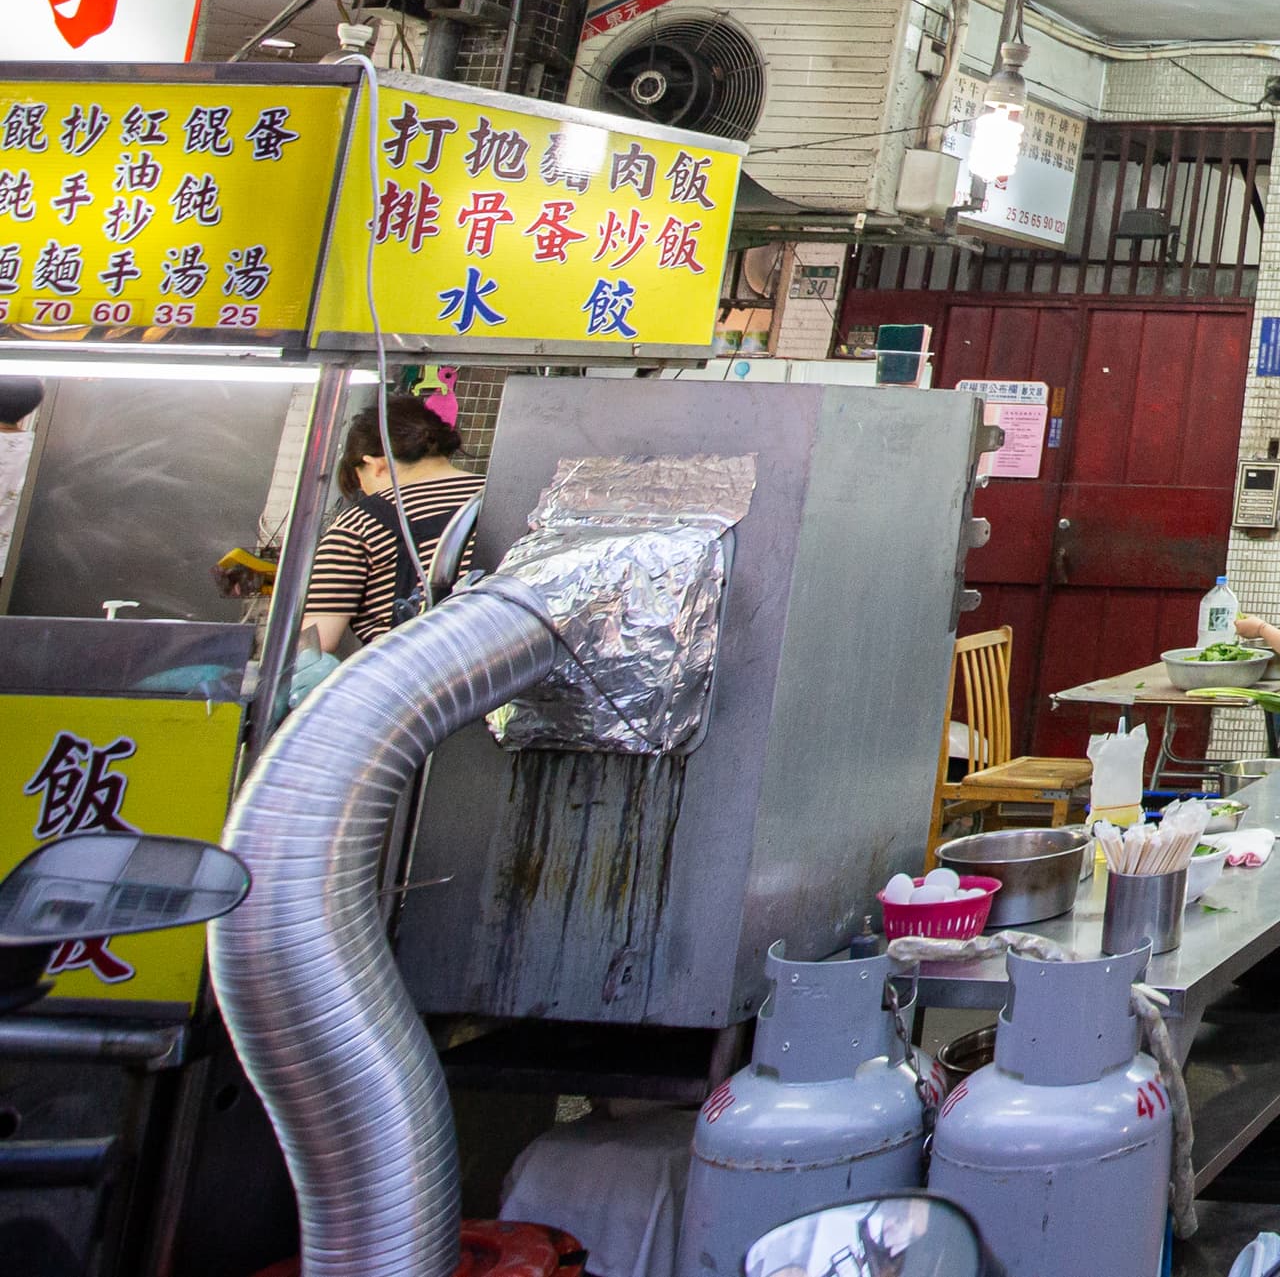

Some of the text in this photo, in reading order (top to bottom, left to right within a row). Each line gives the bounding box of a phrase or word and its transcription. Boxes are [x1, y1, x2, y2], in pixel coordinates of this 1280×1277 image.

[33, 103, 110, 297] 抄手麵
[99, 104, 169, 297] 紅油抄手
[159, 105, 234, 299] 餛飩湯
[221, 106, 300, 302] 蛋湯
[369, 180, 706, 274] 排骨蛋炒飯
[34, 301, 73, 324] 70
[92, 302, 132, 324] 60
[154, 303, 195, 327] 35
[217, 305, 260, 328] 25
[438, 267, 640, 339] 水餃
[24, 730, 144, 840] 飯
